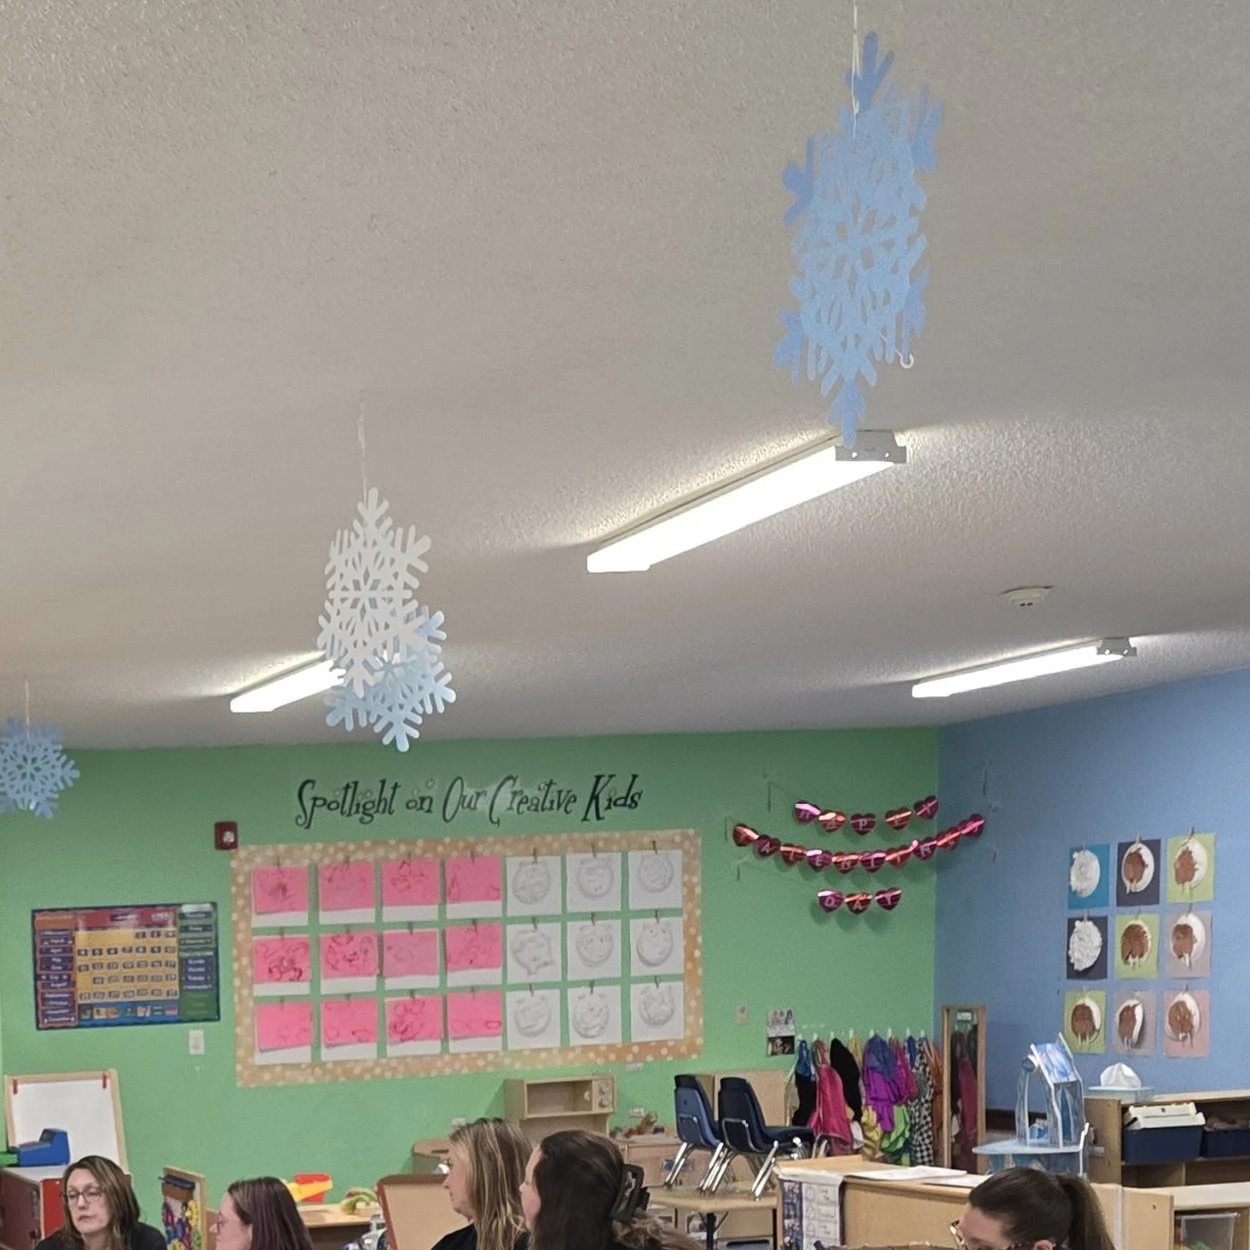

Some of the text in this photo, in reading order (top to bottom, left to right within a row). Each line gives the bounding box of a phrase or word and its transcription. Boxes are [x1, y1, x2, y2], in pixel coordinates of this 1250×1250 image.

[295, 774, 643, 829] Spotlight on Our Creative Kids
